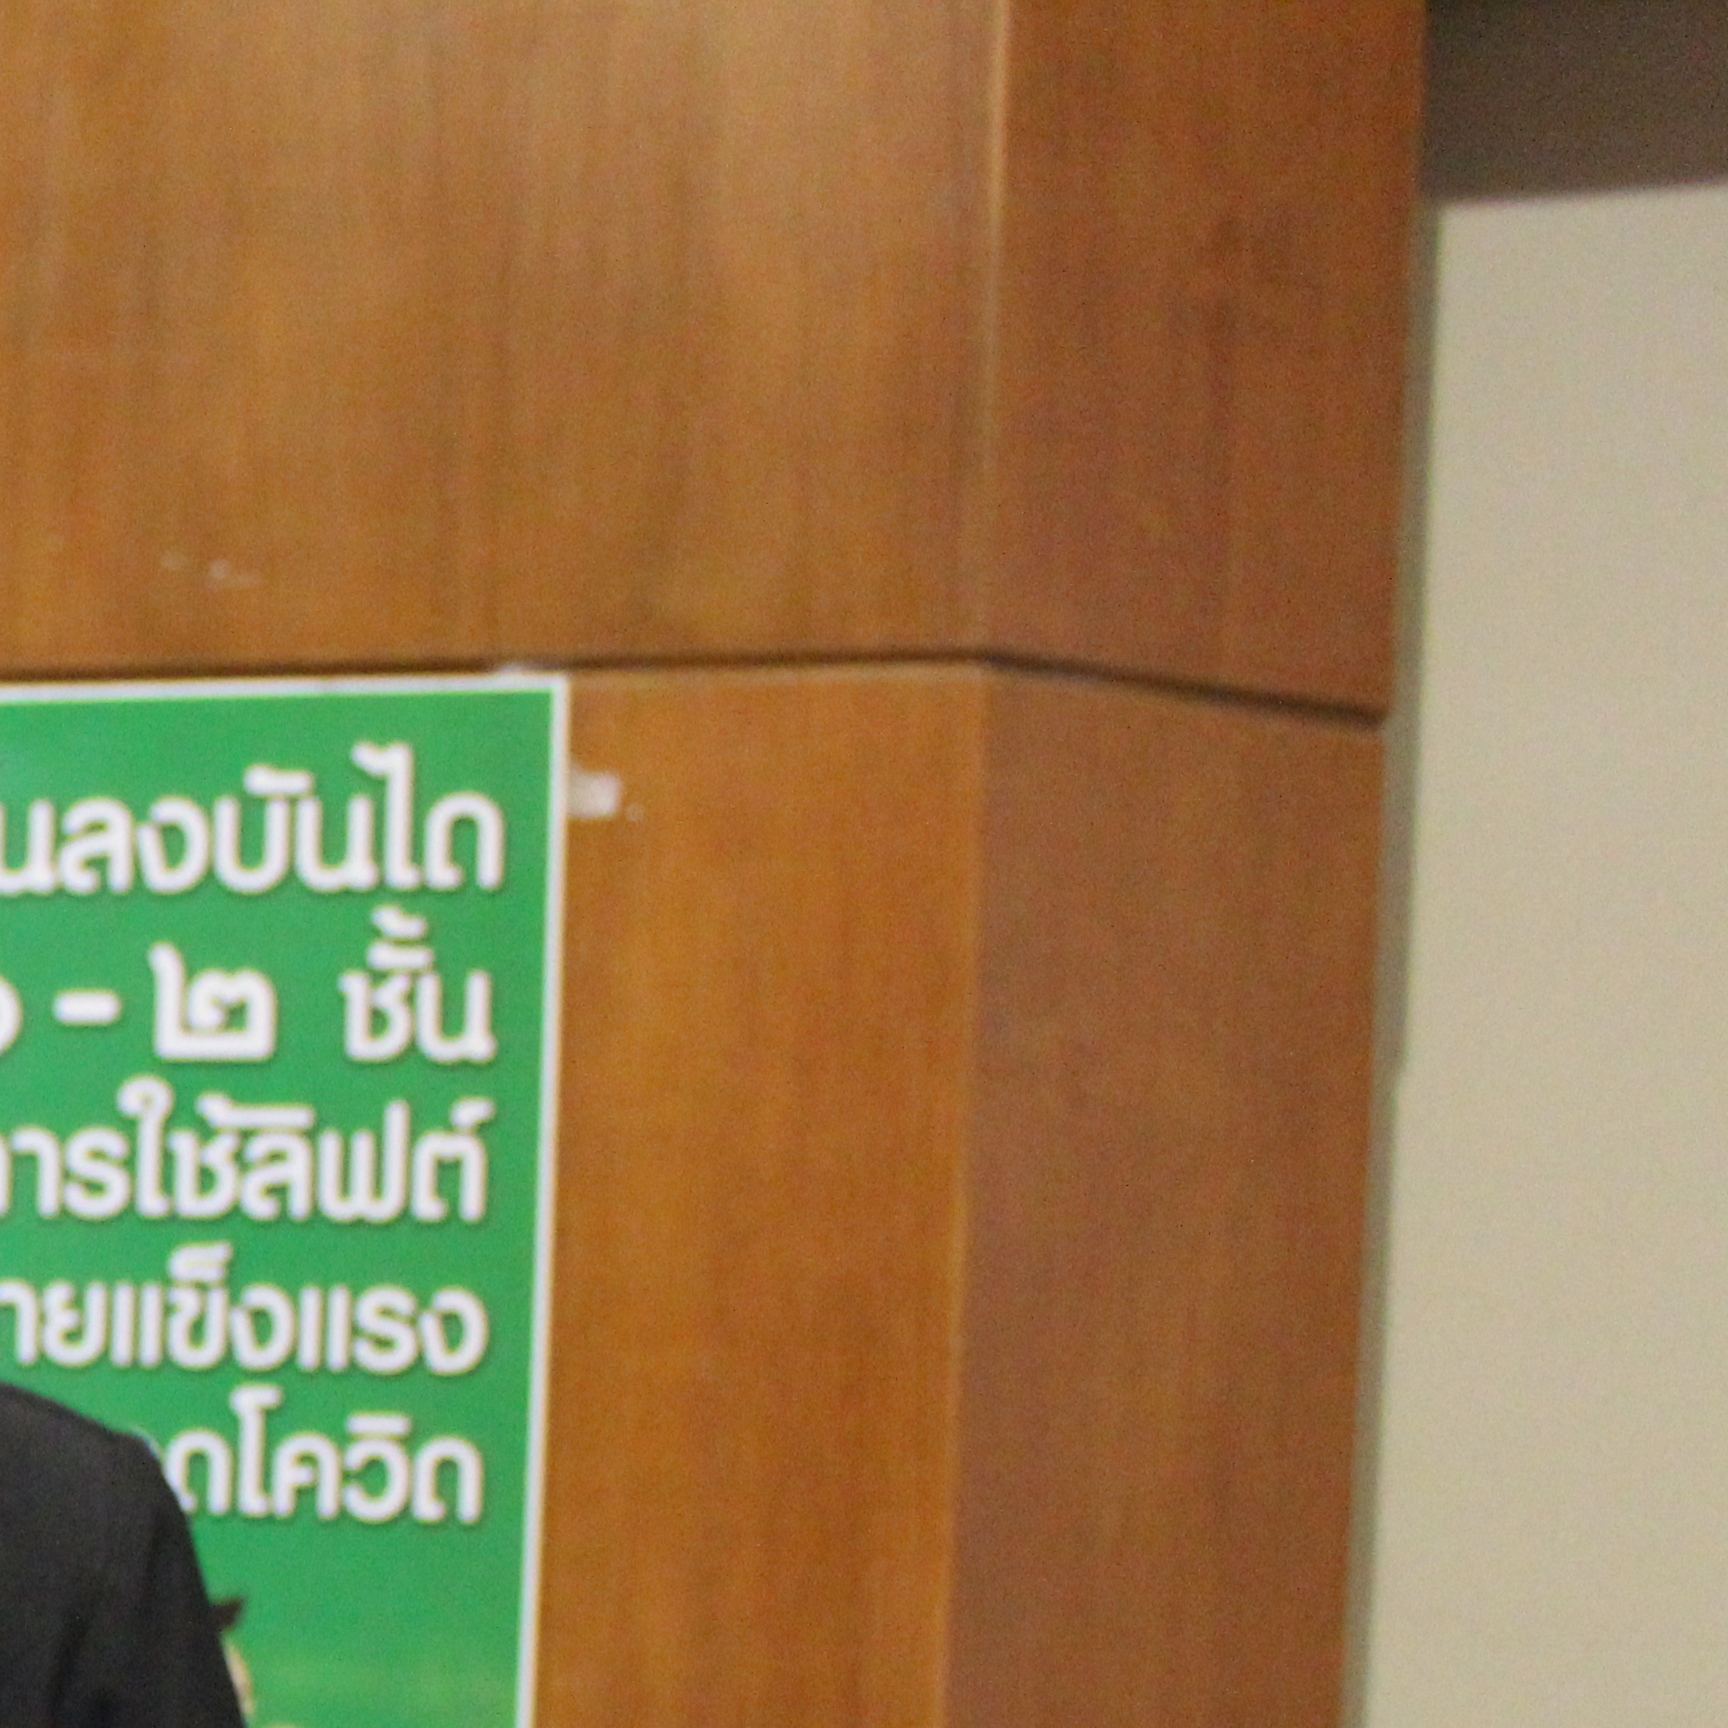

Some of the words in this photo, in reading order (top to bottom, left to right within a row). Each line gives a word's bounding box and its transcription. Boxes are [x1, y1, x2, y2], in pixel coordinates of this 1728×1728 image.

[148, 942, 276, 1060] ๒
[341, 903, 496, 1061] ชั้น
[138, 1383, 483, 1523] ดโควิด
